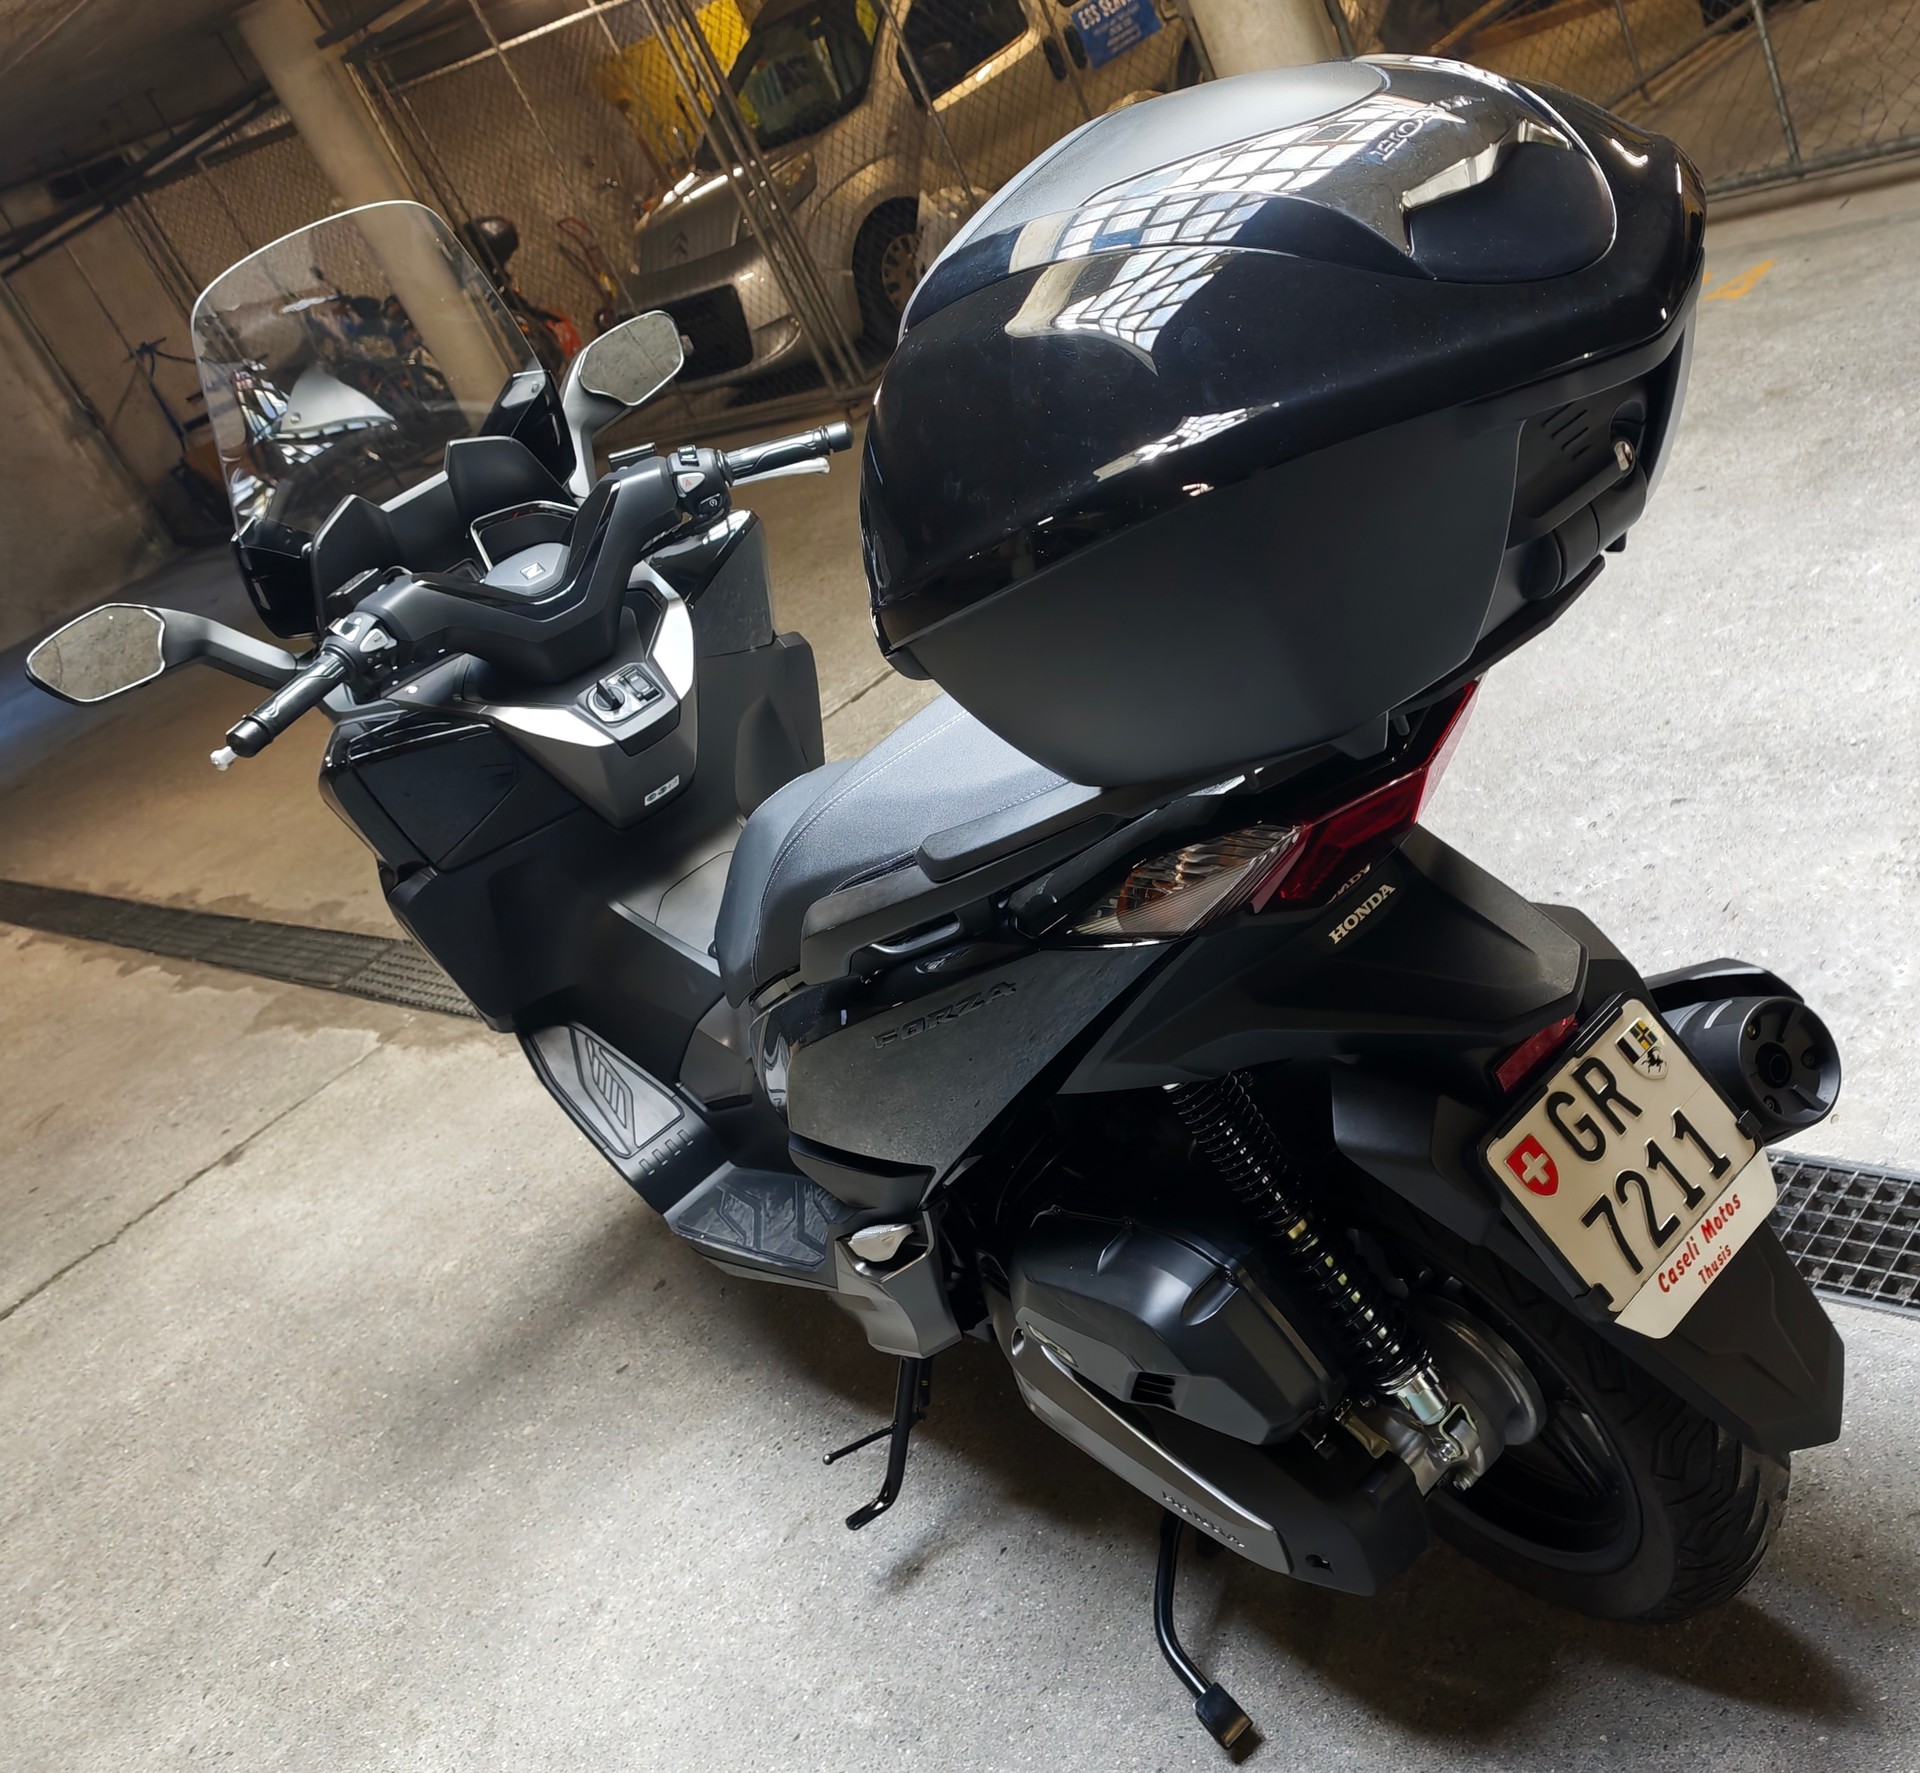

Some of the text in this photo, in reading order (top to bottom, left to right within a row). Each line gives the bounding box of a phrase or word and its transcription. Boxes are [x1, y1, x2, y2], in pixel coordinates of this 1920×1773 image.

[1328, 884, 1396, 945] HONDA
[871, 981, 1017, 1050] FORZA
[1547, 1056, 1644, 1162] GR
[1580, 1108, 1732, 1275] 7211
[1657, 1193, 1741, 1293] Caseli Motos
[1697, 1244, 1732, 1285] Thusis
